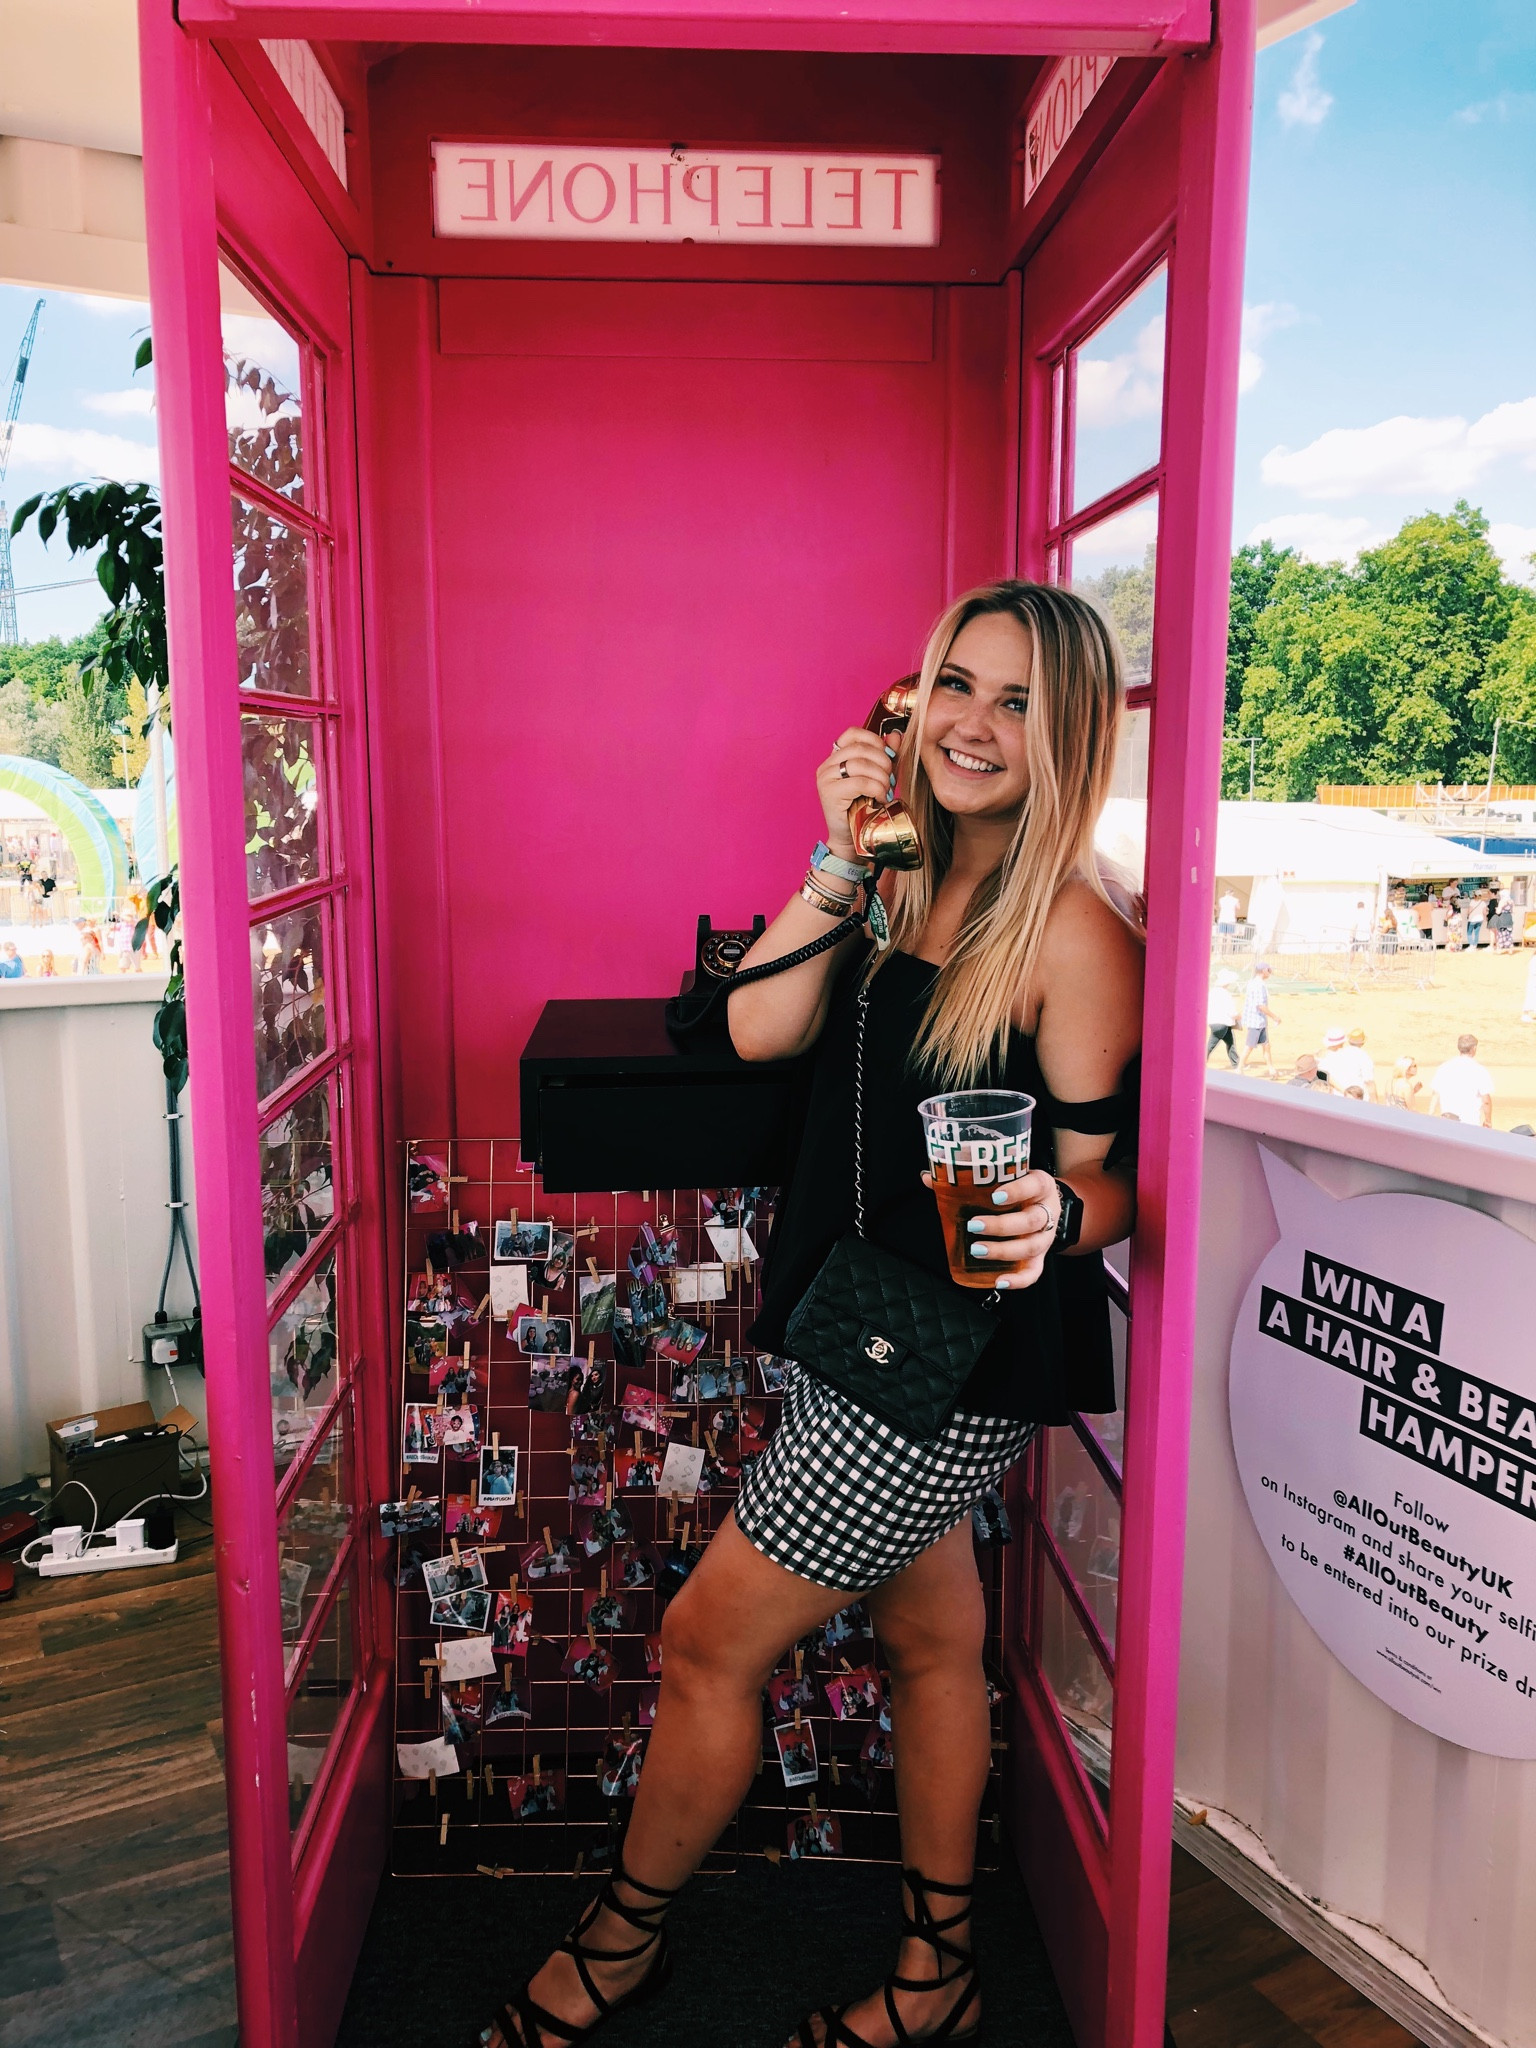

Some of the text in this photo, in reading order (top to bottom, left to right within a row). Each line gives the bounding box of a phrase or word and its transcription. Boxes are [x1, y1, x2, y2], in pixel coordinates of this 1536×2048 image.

[1311, 1260, 1432, 1343] WIN A
[1266, 1299, 1536, 1450] A HAIR & BEA
[1367, 1396, 1536, 1511] HAMPER
[1261, 1475, 1278, 1493] on
[1283, 1482, 1356, 1538] Instagram
[1361, 1532, 1393, 1559] and
[1398, 1550, 1445, 1588] share
[1450, 1582, 1493, 1615] your
[1333, 1489, 1514, 1600] @AllOutBeautyUK
[1393, 1490, 1450, 1534] Follow
[1281, 1533, 1536, 1699] to be entered into our prize dr
[1343, 1544, 1490, 1644] #AllOutBeauty
